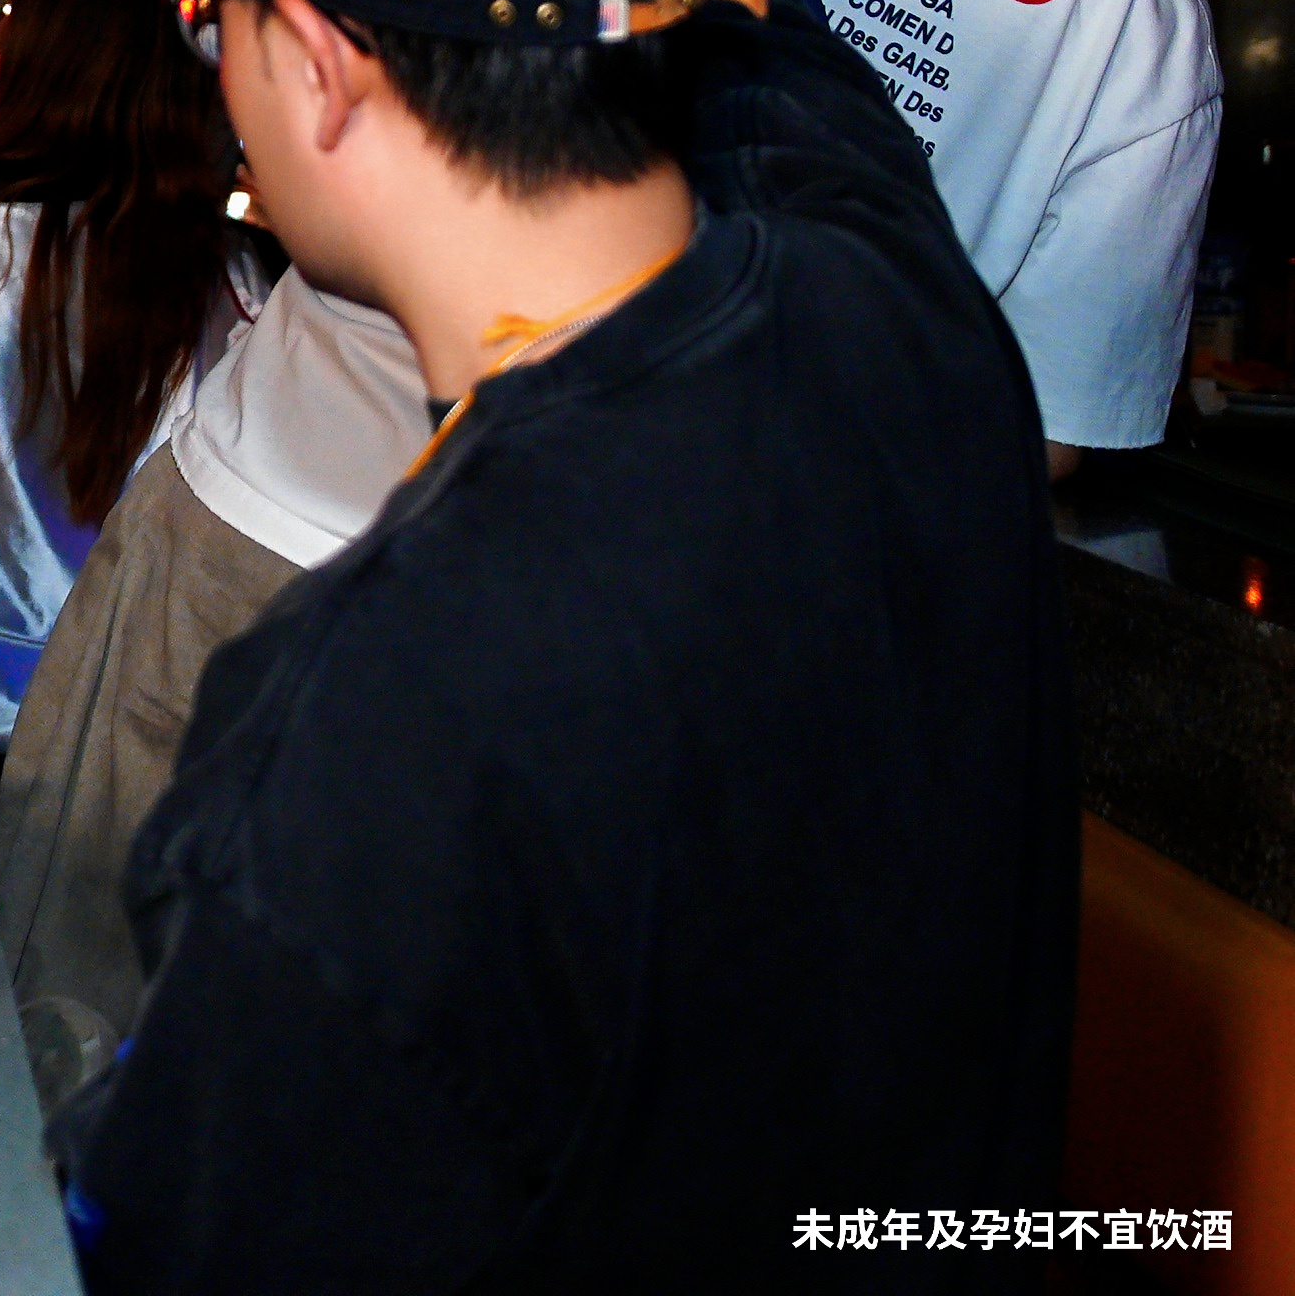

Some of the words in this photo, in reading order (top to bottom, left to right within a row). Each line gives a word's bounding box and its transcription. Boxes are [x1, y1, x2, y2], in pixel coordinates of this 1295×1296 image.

[834, 16, 878, 52] Des
[882, 42, 950, 91] GARB
[903, 90, 944, 122] Des
